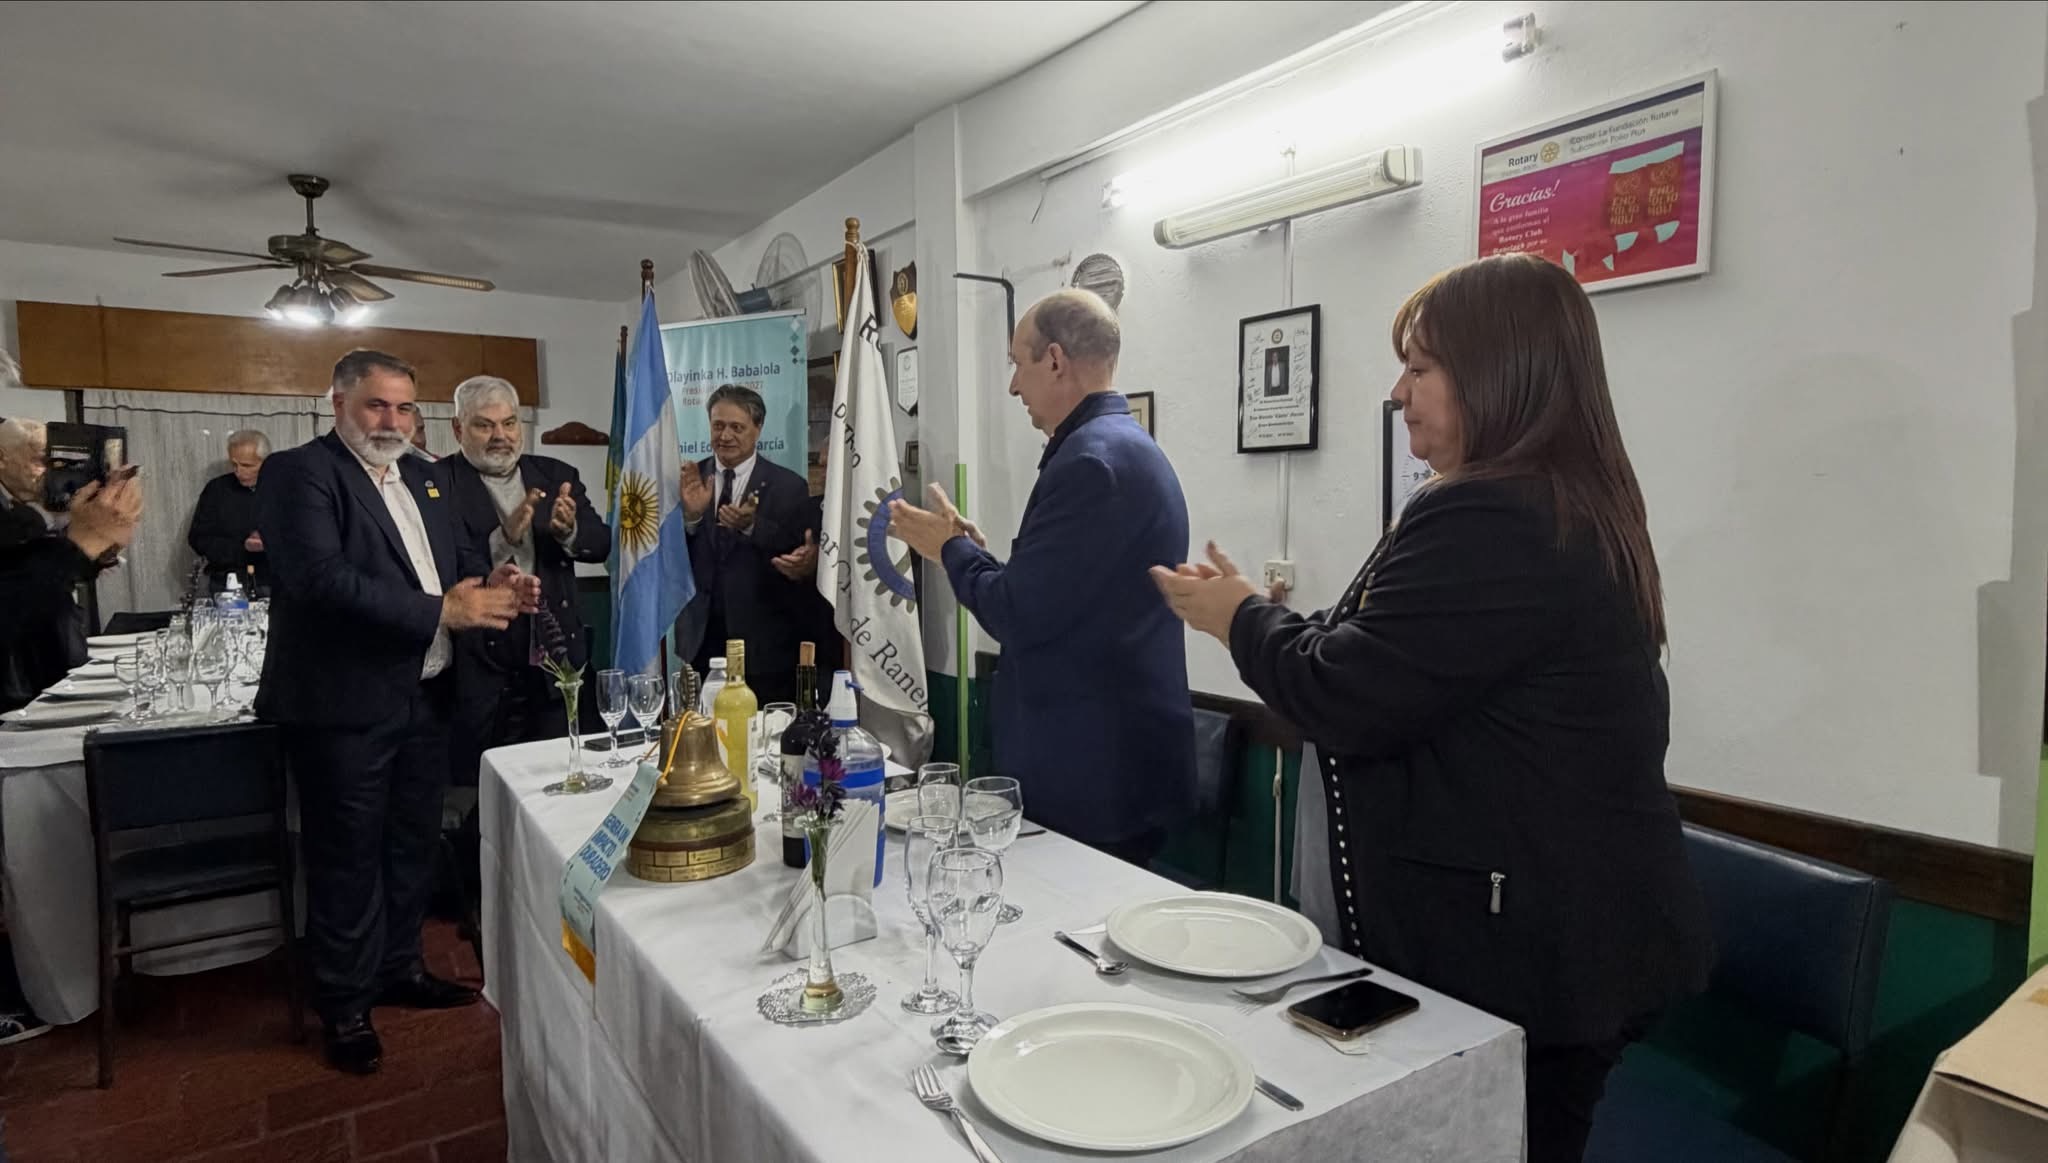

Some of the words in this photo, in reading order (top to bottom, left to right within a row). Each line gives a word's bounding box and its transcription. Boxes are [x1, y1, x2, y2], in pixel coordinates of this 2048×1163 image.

[1508, 152, 1538, 167] Rotary
[1489, 178, 1560, 213] Gracias!
[717, 366, 728, 380] H.
[731, 362, 780, 378] Babalola
[757, 436, 784, 451] arcía
[850, 616, 872, 647] de
